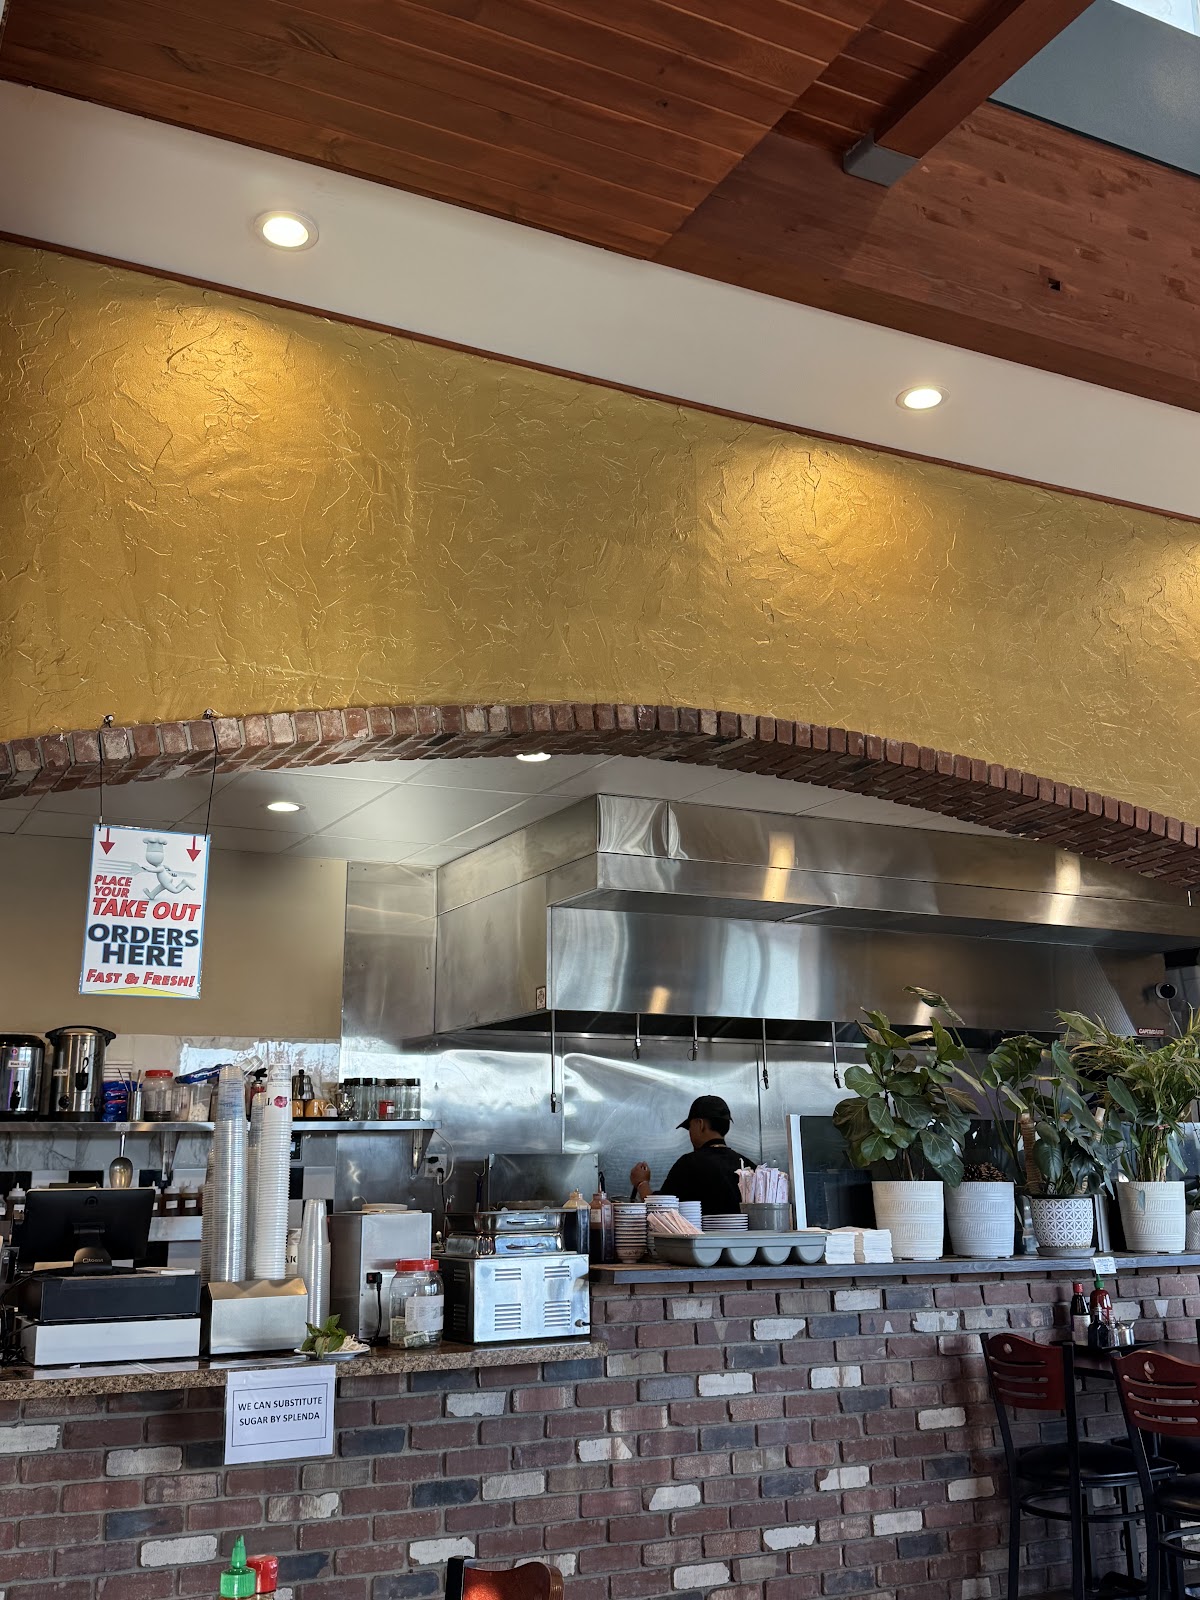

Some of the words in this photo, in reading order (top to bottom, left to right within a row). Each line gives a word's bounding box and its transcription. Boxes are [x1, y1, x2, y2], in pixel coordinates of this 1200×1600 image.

[94, 875, 132, 887] PLACE
[94, 886, 129, 898] YOUR
[92, 898, 149, 918] TAKE
[152, 901, 201, 921] OUT
[88, 924, 199, 947] ORDERS
[102, 943, 183, 967] HERE
[125, 973, 139, 984] &
[238, 1402, 251, 1411] WE
[253, 1400, 271, 1410] CAN
[273, 1396, 323, 1408] SUBSTITUTE
[239, 1416, 268, 1426] SUGAR
[270, 1415, 281, 1423] BY
[283, 1412, 320, 1422] SPLENDA
